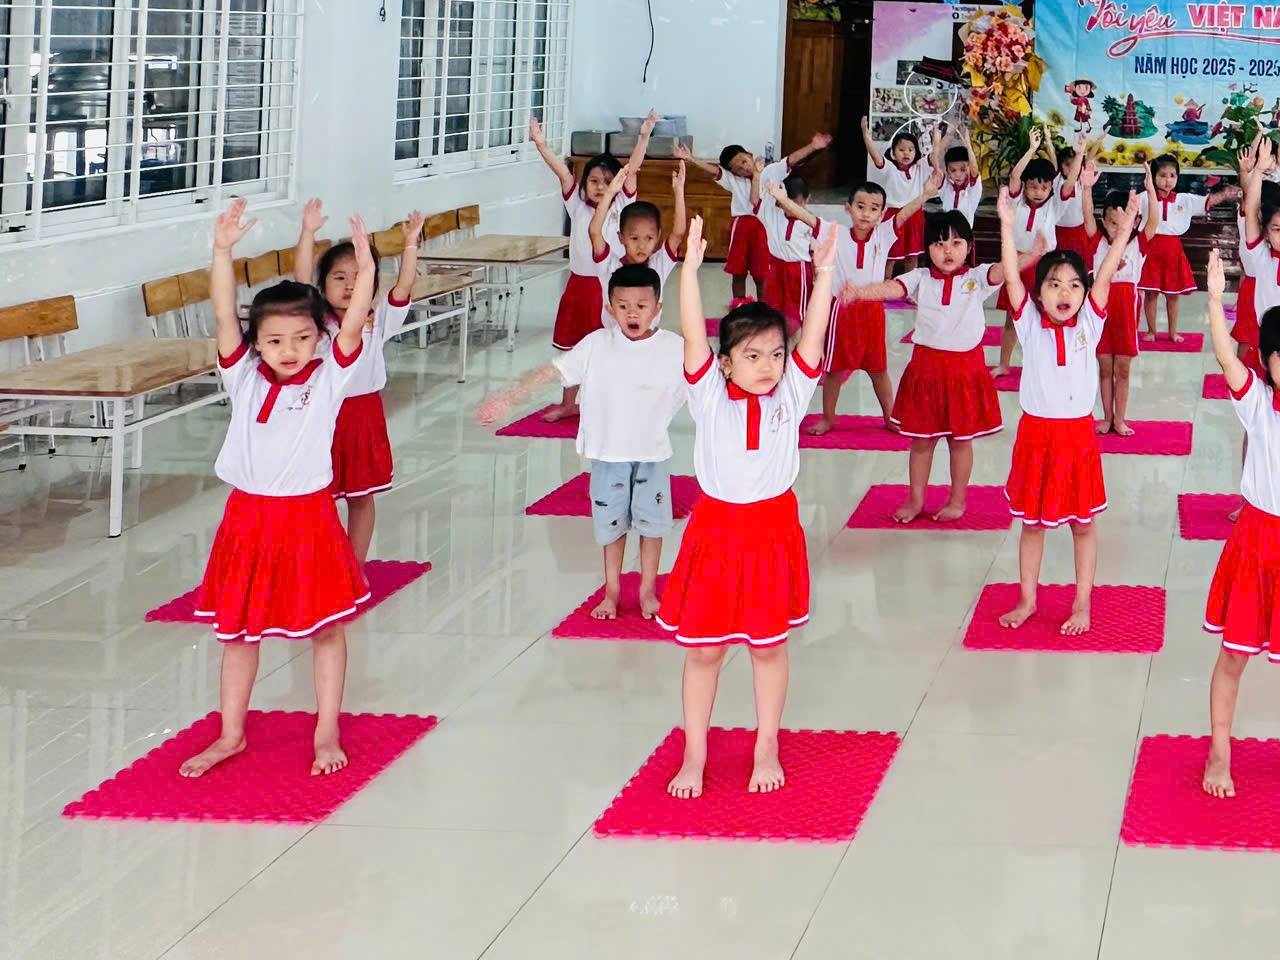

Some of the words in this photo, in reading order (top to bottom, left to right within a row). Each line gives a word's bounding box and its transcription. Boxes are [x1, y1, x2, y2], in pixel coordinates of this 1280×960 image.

[1188, 0, 1246, 34] VIỆT
[1134, 53, 1167, 74] NĂM
[1171, 57, 1198, 79] HỌC
[1202, 58, 1236, 76] 2025
